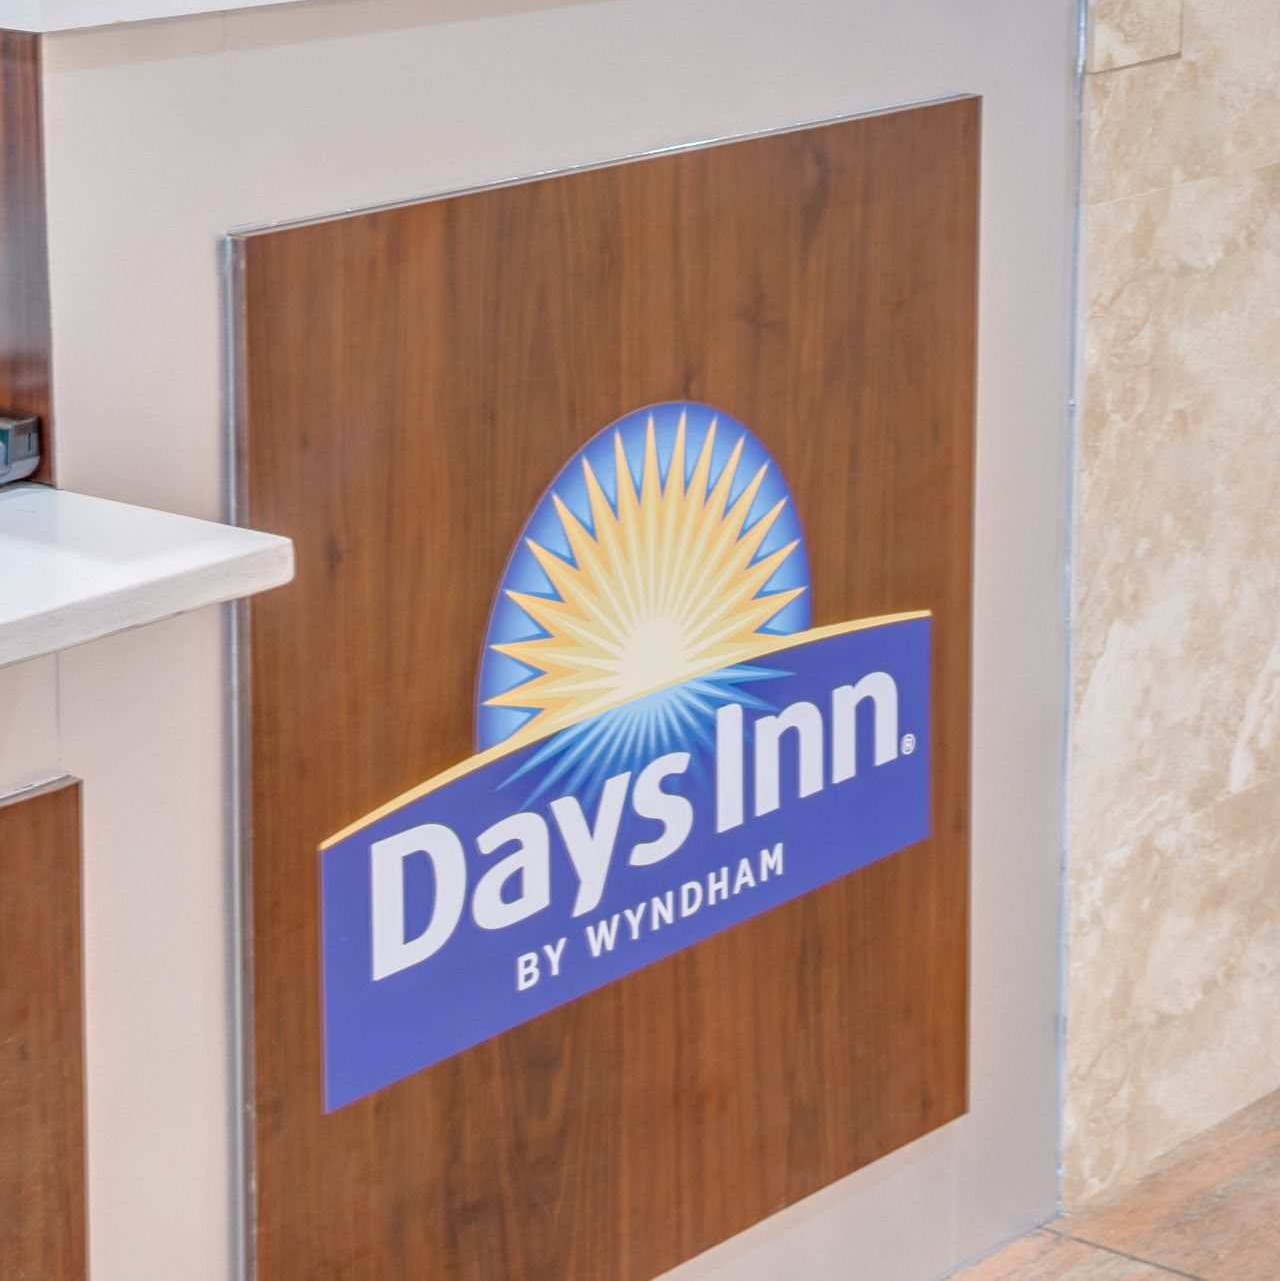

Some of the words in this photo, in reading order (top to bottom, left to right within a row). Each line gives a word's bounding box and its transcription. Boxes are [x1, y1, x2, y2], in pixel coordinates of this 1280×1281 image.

[371, 749, 695, 983] Days
[516, 938, 567, 992] BY
[585, 841, 786, 958] WYNDHAM
